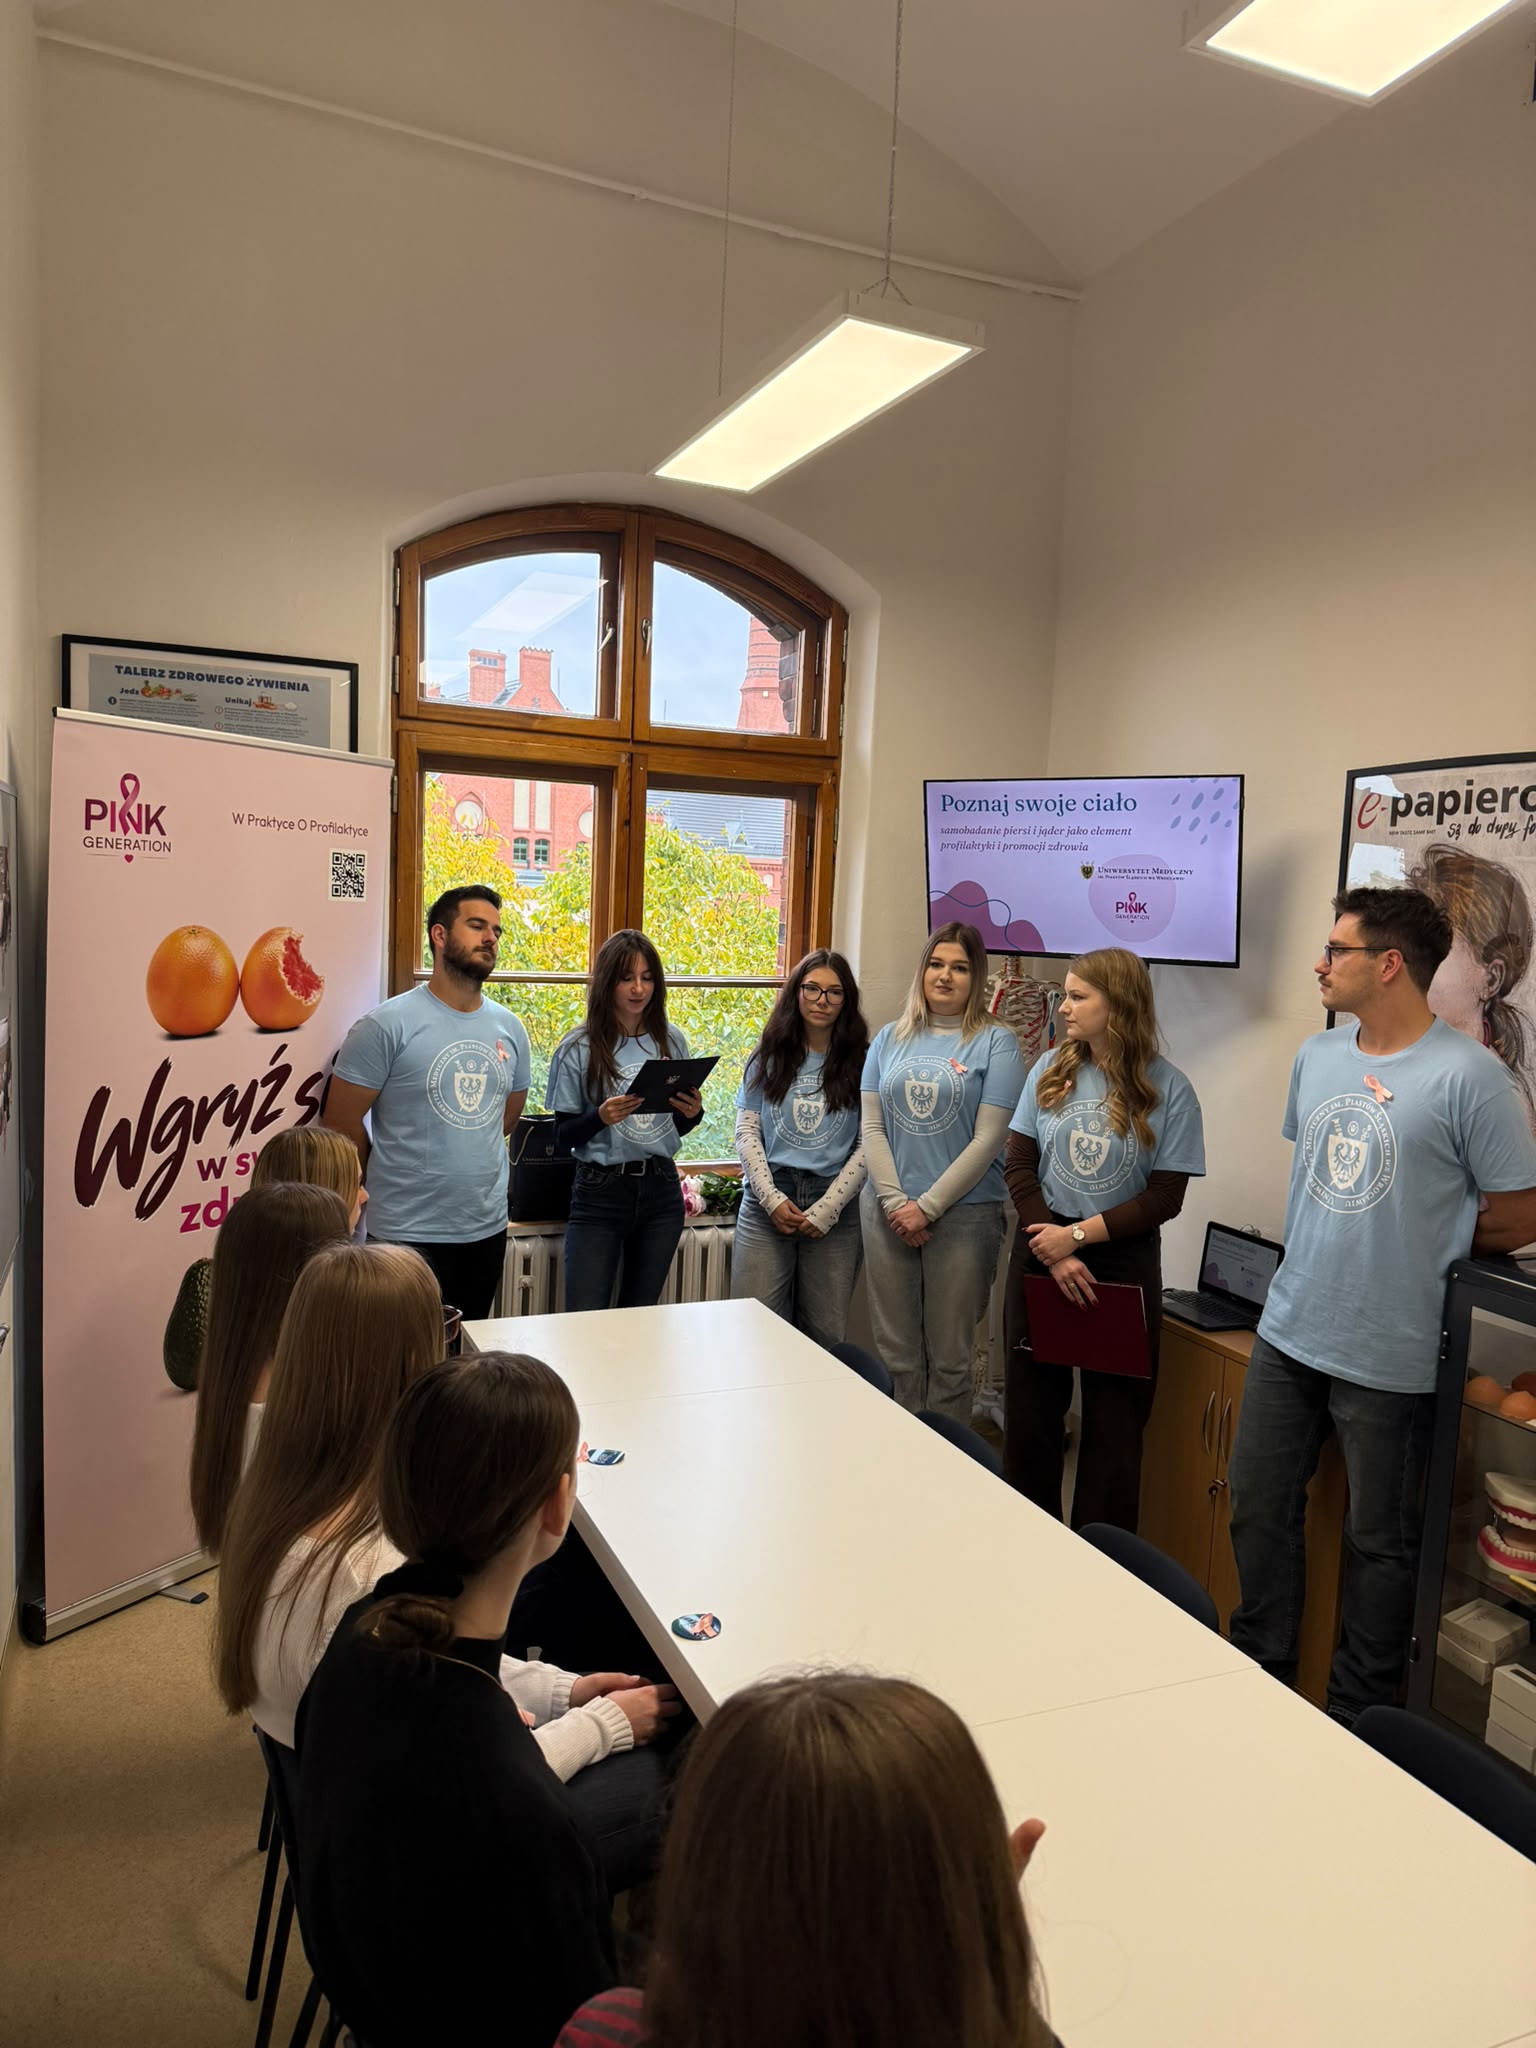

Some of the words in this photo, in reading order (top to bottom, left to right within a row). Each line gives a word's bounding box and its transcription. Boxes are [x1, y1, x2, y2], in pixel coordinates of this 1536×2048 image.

[115, 665, 165, 678] TALERZ
[168, 670, 244, 686] ZDROWEGO
[246, 674, 310, 692] ŻYWIENIA
[120, 686, 140, 696] Jedz
[225, 696, 252, 707] Unikaj
[941, 794, 1010, 817] Poznaj
[1015, 794, 1077, 817] swoje
[1083, 792, 1137, 812] ciało
[84, 797, 167, 837] PINK
[232, 812, 246, 825] W
[247, 813, 295, 832] Praktyce
[297, 819, 308, 832] O
[310, 819, 369, 838] Profilaktyce
[940, 826, 1001, 836] samobadanie
[1003, 826, 1030, 838] piersi
[1032, 826, 1037, 836] i
[1038, 826, 1064, 838] jąder
[1066, 826, 1088, 838] jako
[1090, 826, 1132, 836] element
[1468, 816, 1482, 836] do
[1486, 816, 1520, 840] dupy
[83, 836, 172, 854] GENERATION
[940, 841, 996, 852] profilaktyki
[996, 842, 1001, 850] i
[1002, 842, 1046, 852] promocji
[1048, 842, 1088, 851] zdrowia
[1098, 866, 1150, 874] UNIWERSYTET
[1152, 867, 1194, 875] MEDYCZNY
[1116, 902, 1147, 914] PINK
[74, 1043, 292, 1222] Wgryź
[197, 1156, 227, 1182] w
